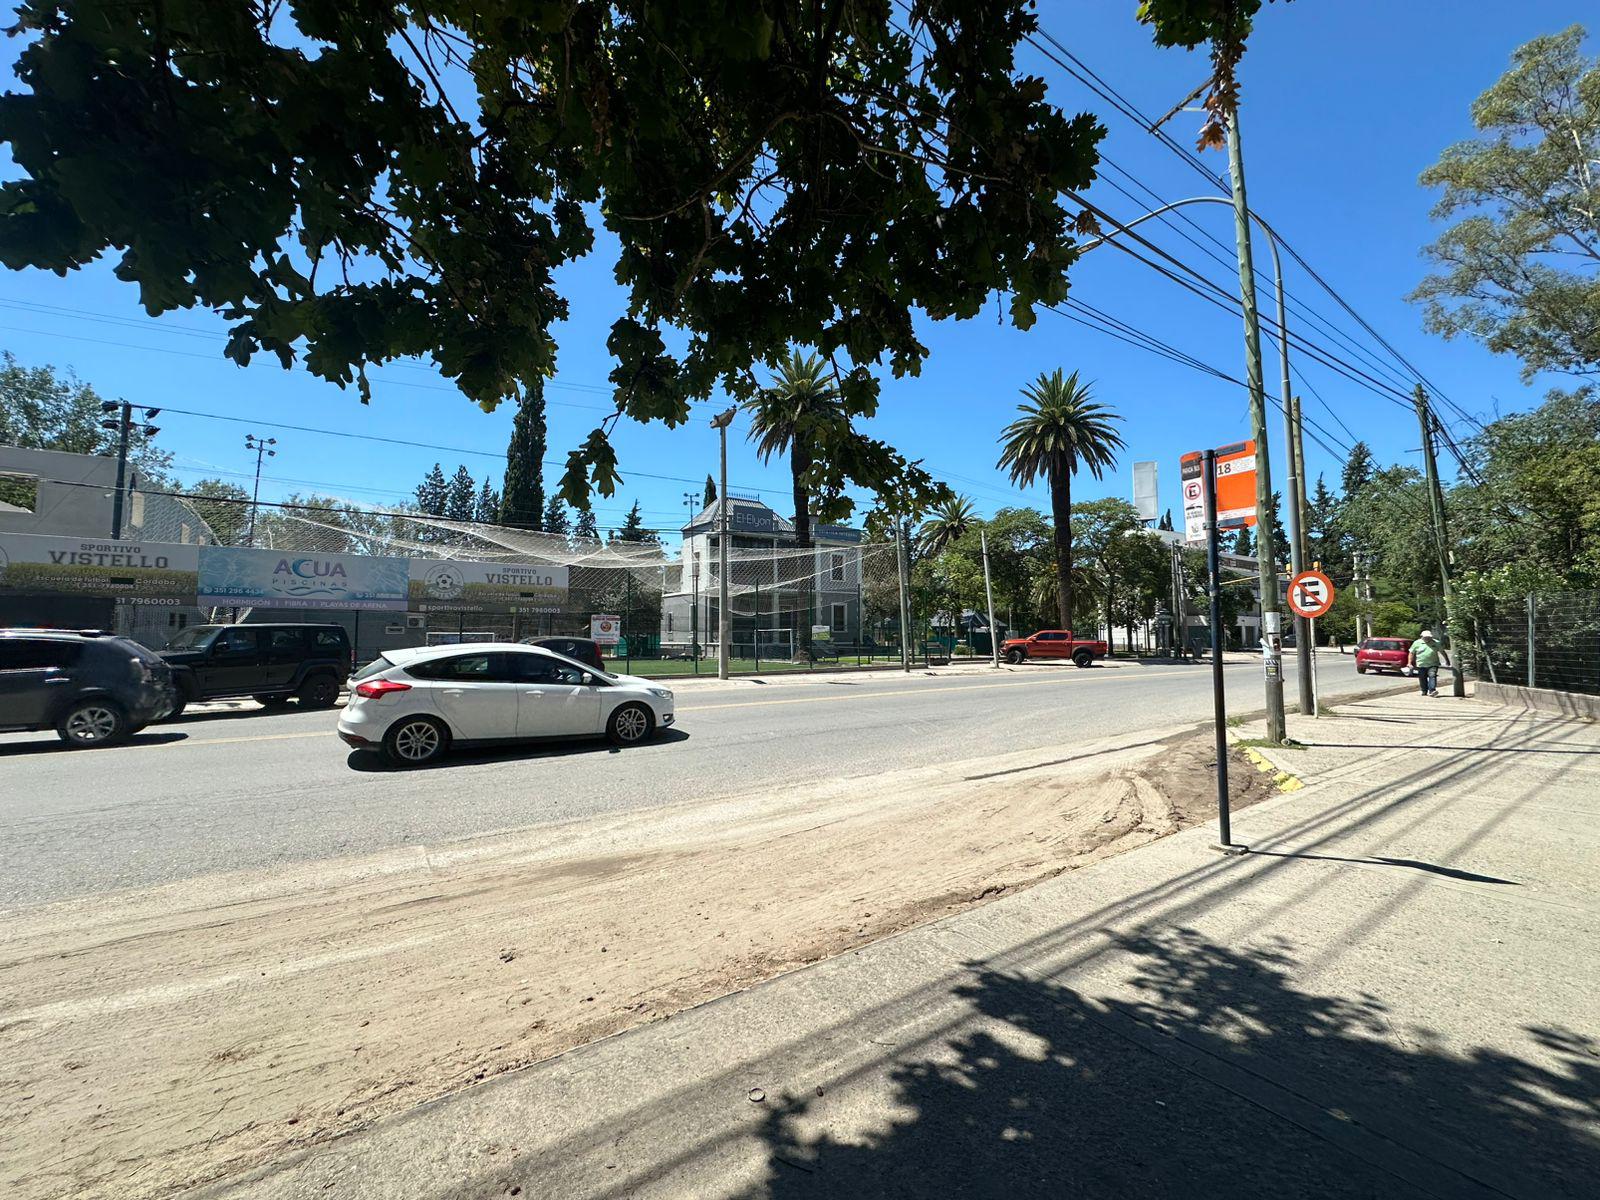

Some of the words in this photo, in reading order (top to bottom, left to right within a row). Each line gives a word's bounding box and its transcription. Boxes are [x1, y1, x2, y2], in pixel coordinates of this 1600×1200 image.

[1218, 464, 1231, 475] 18
[81, 543, 141, 554] SPORTIVO
[48, 551, 169, 569] VISTELLO
[272, 558, 348, 579] ACUA
[502, 567, 537, 575] SPORTIVO
[272, 578, 348, 587] PISCINAS
[485, 573, 553, 586] VISTELLO
[1299, 581, 1320, 607] E
[130, 597, 180, 606] 7960003
